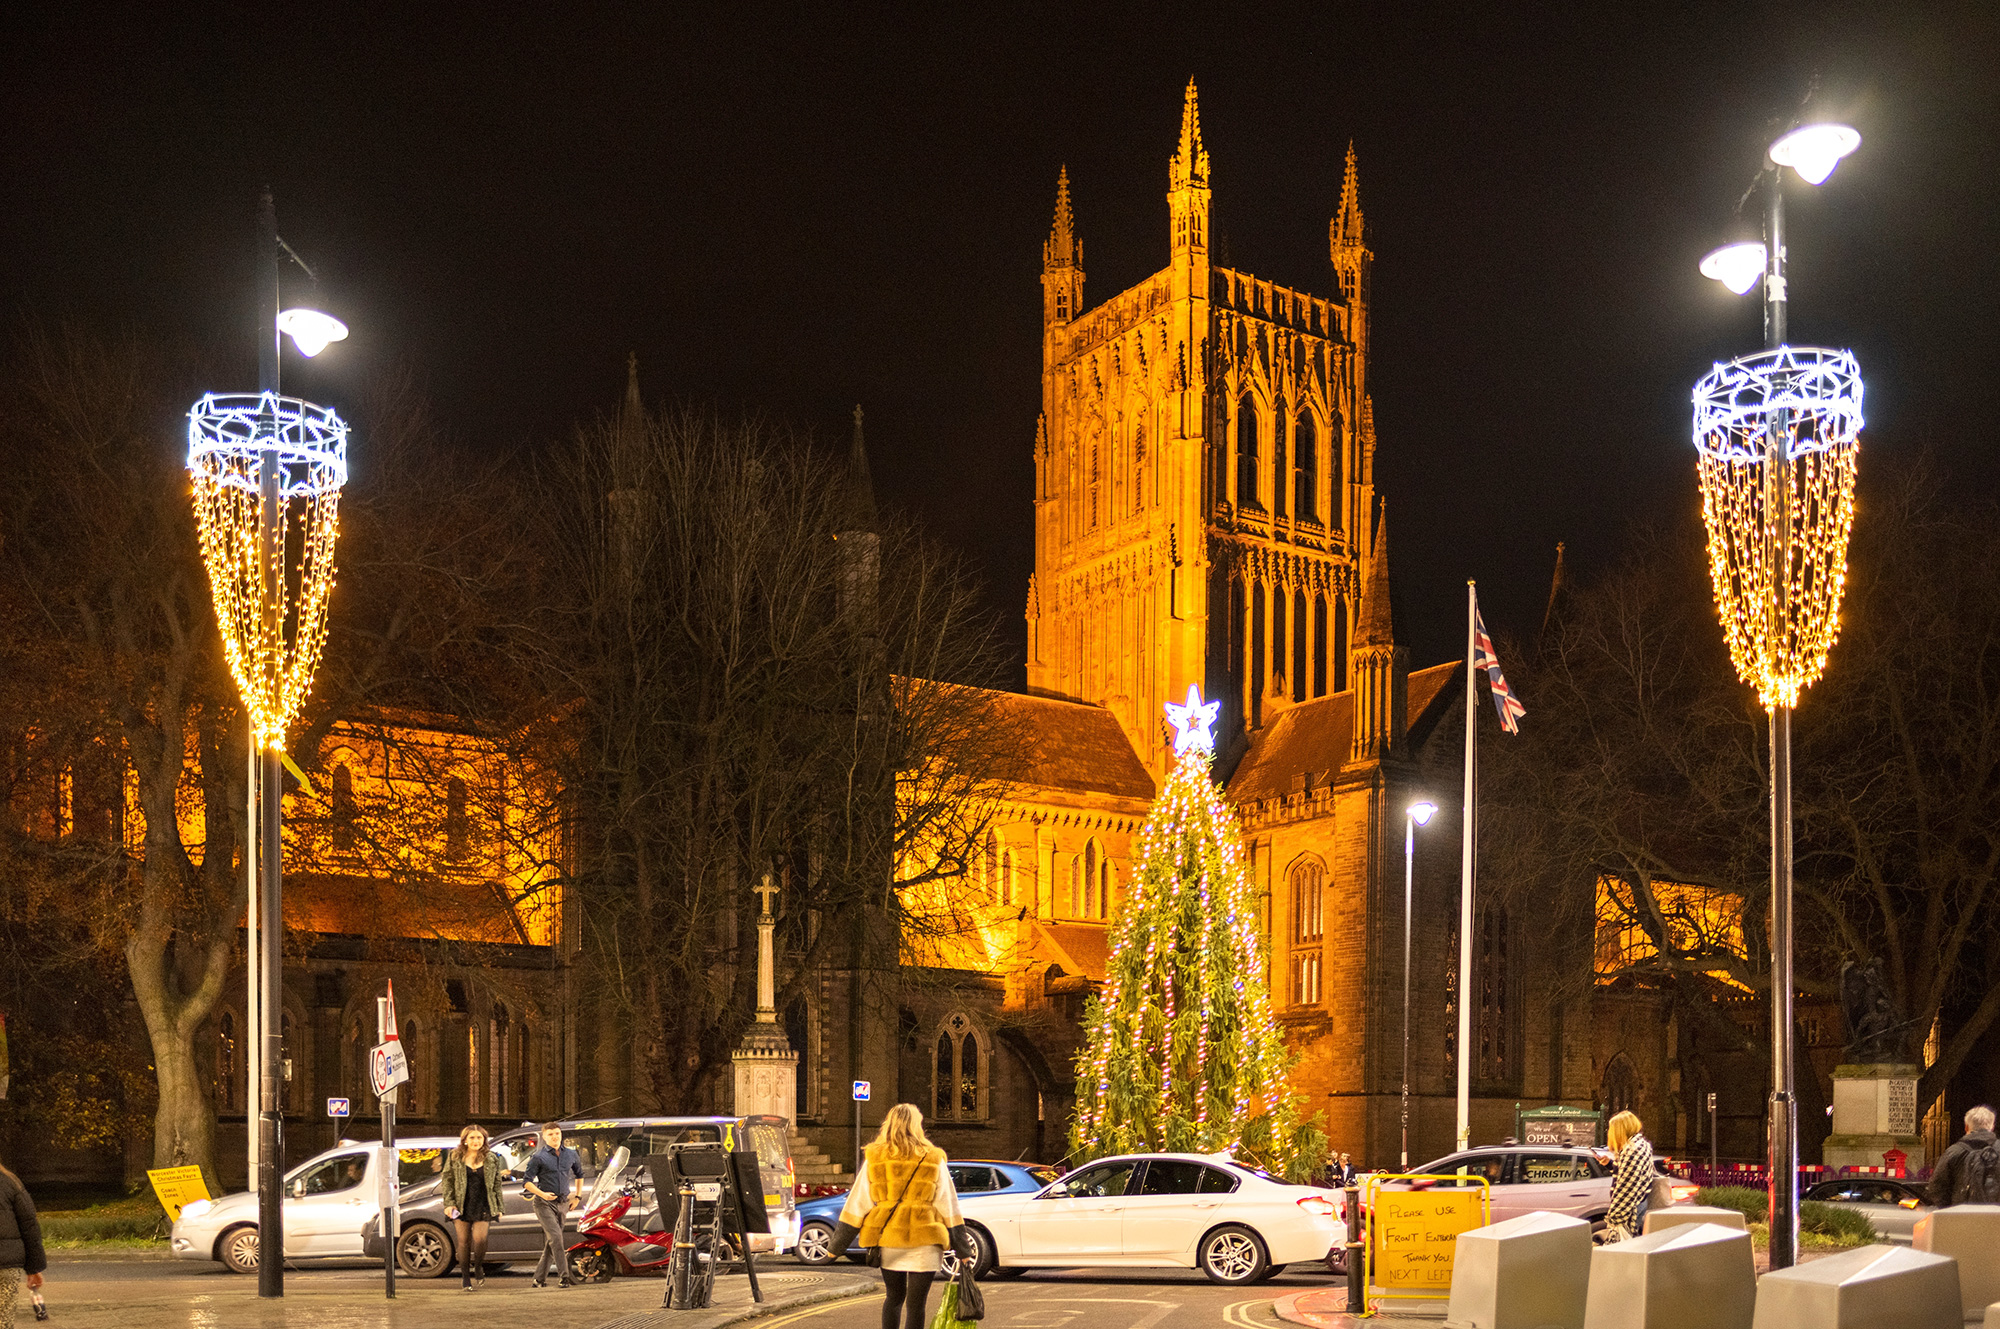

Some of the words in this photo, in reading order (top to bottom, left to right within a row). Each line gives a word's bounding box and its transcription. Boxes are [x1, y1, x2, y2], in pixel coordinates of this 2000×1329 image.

[1526, 1134, 1559, 1143] OPEN
[1389, 1204, 1425, 1218] PLEASE
[1435, 1206, 1457, 1216] USE
[1386, 1227, 1419, 1245] FRONT
[1402, 1252, 1431, 1263] THANK
[1389, 1269, 1420, 1280] NEXT
[1427, 1269, 1453, 1281] LEFT
